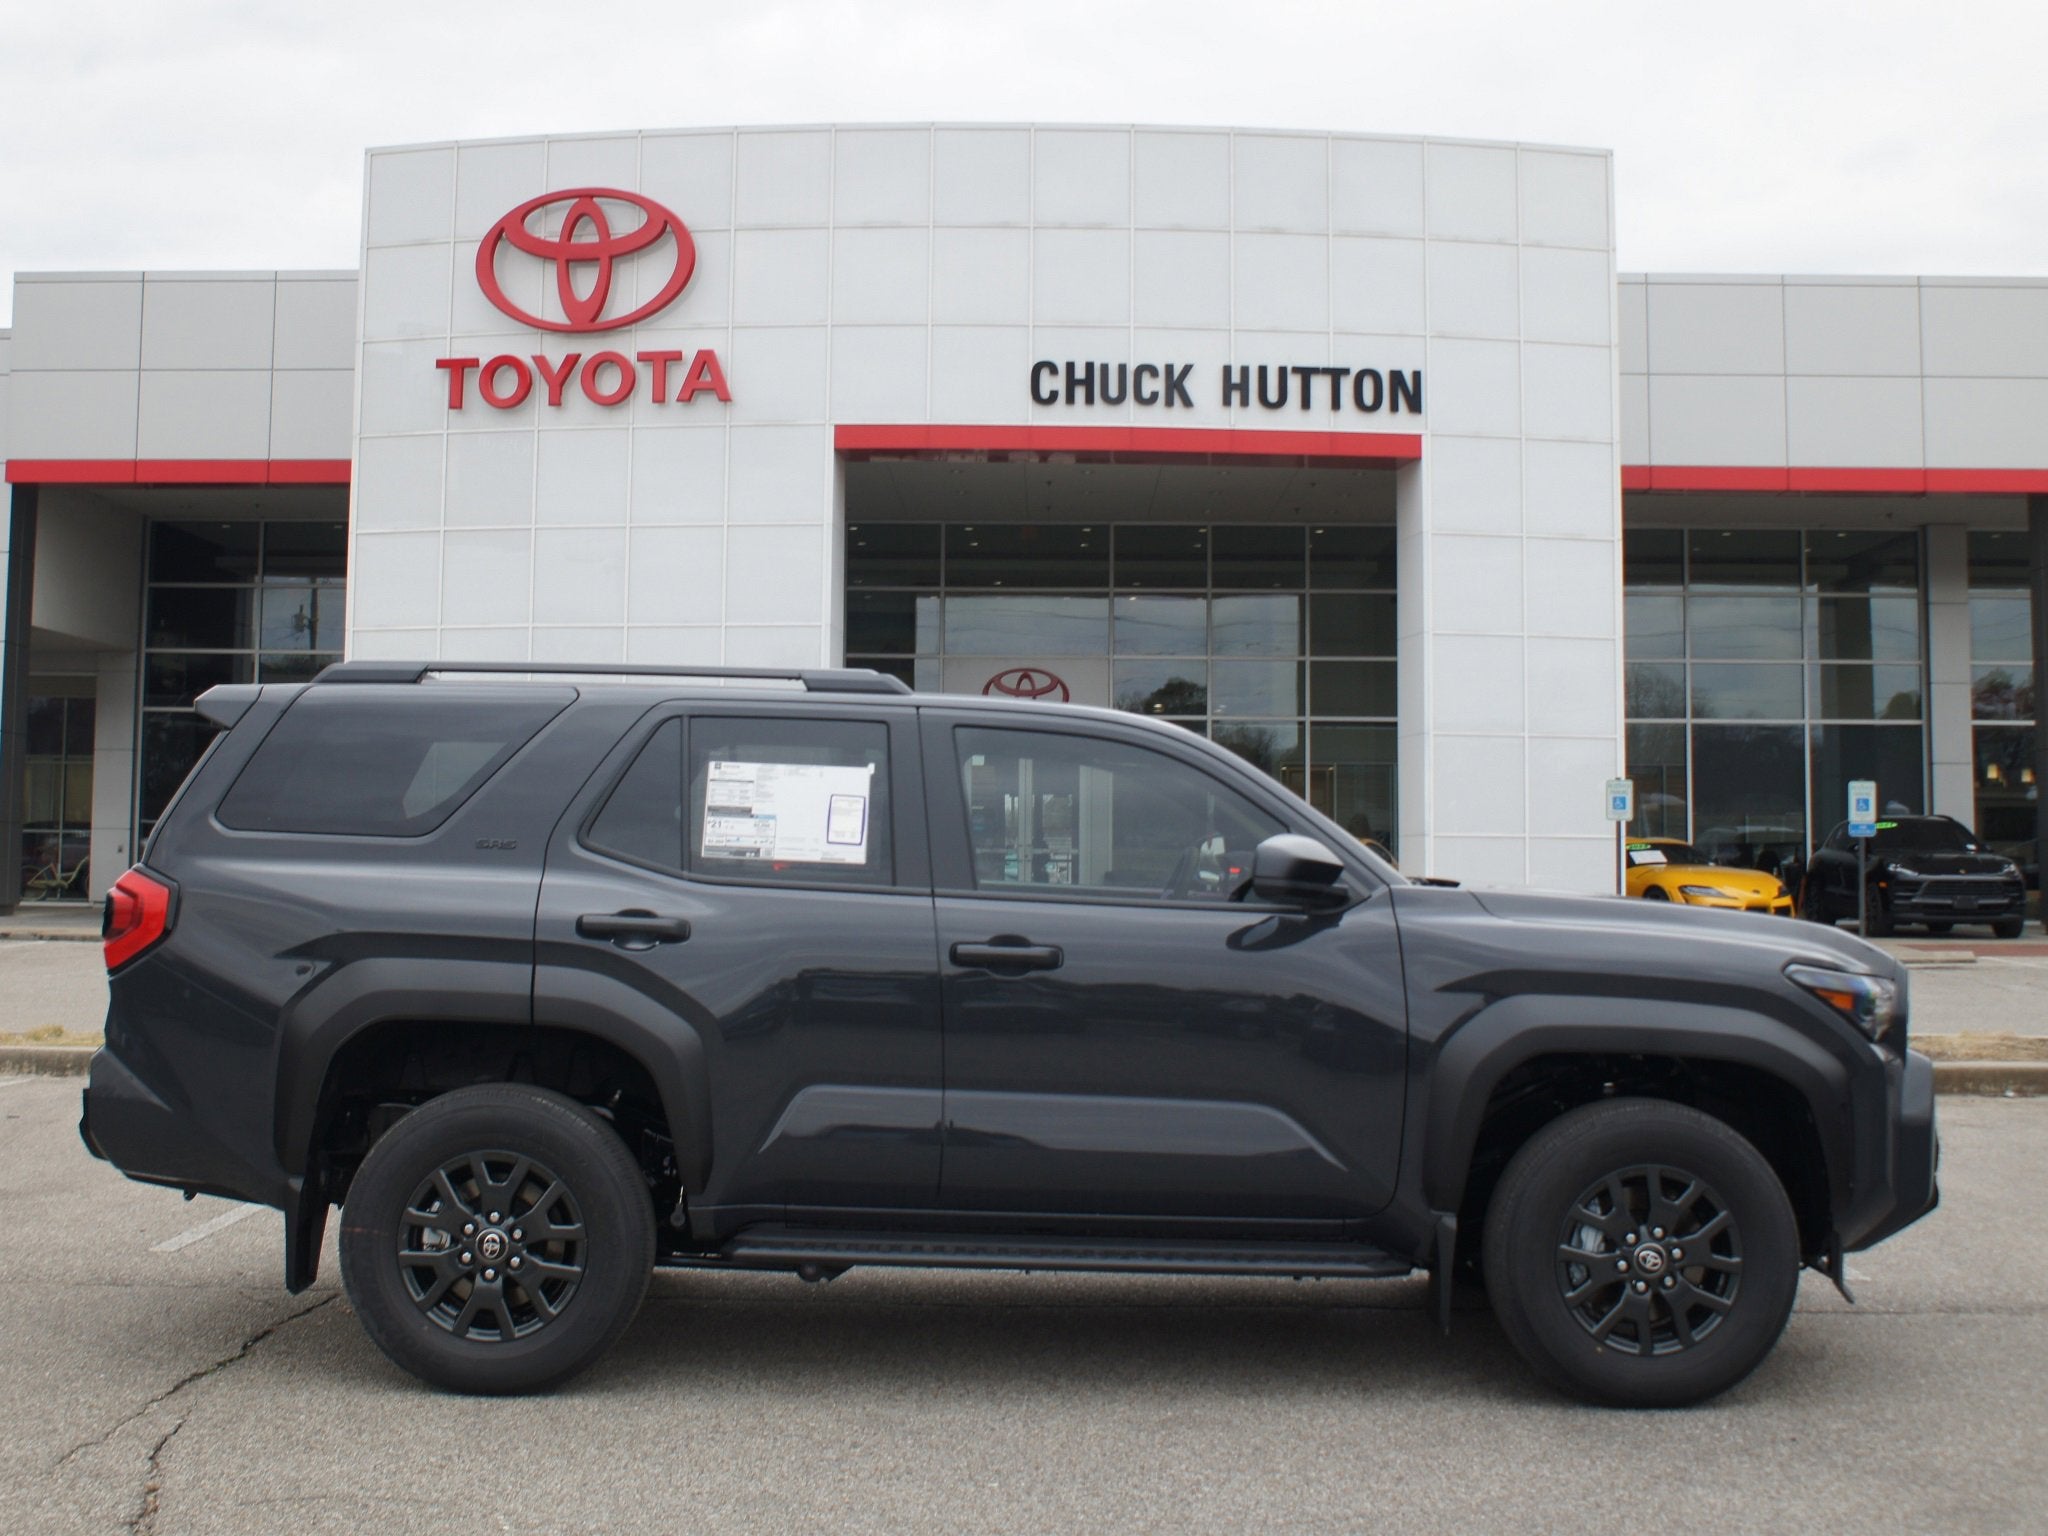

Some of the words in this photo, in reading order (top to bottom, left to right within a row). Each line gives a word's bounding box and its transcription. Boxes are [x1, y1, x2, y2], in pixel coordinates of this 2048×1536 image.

[436, 350, 733, 410] TOYOTA
[1030, 360, 1194, 408] CHUCK
[1222, 365, 1422, 415] HUTTON
